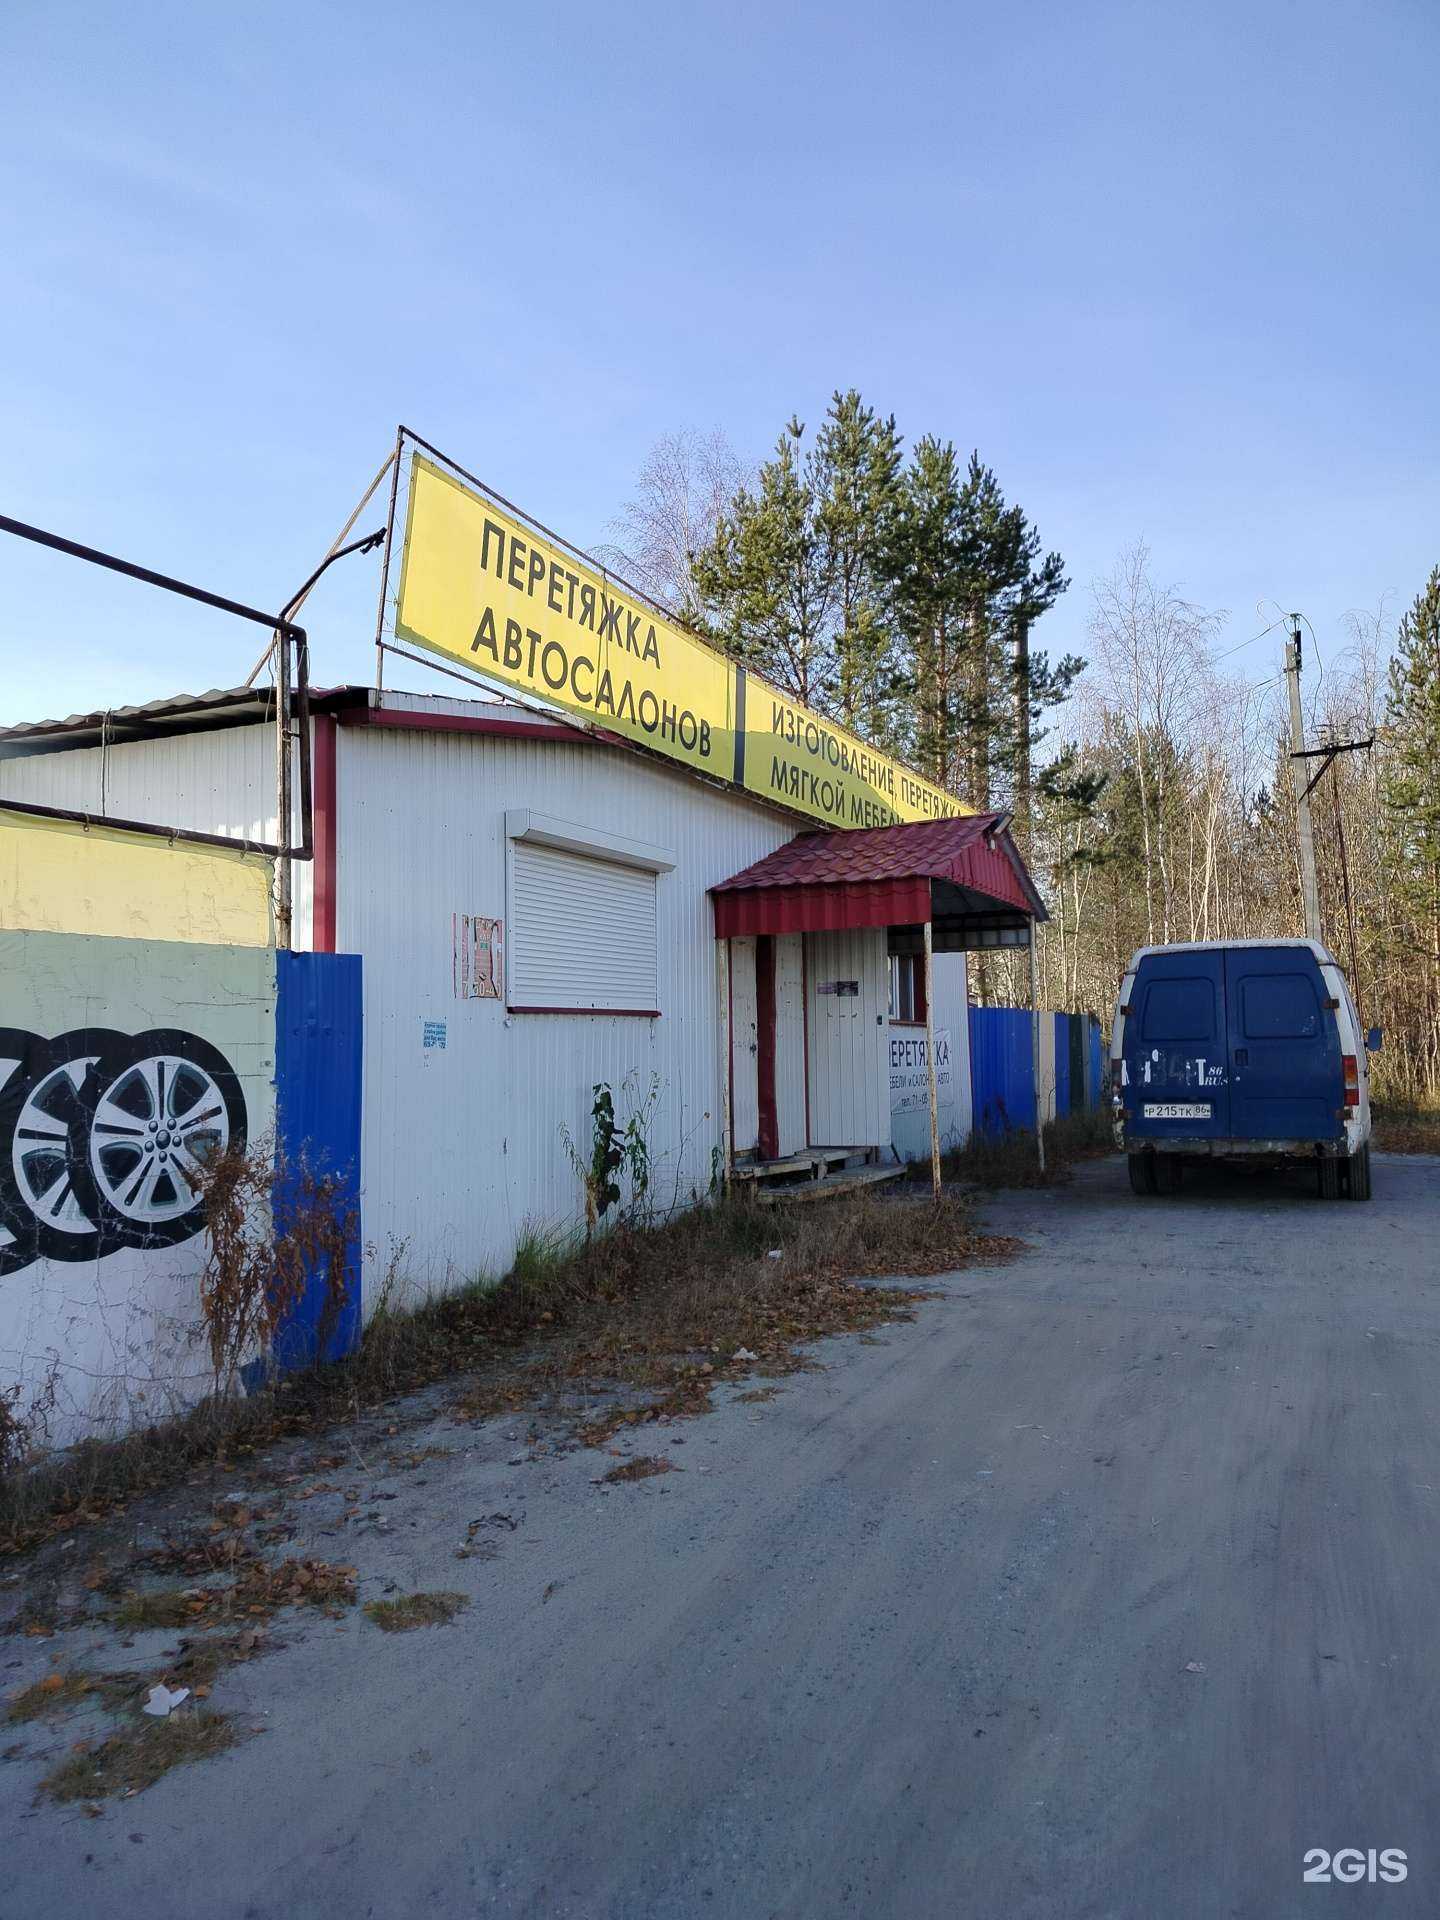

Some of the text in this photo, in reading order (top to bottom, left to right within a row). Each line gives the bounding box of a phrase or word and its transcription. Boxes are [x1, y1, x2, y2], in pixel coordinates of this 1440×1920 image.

[480, 518, 661, 670] ПЕРЕТЯЖКА
[471, 606, 712, 758] АВТОСАЛОНОВ
[770, 755, 845, 818] МЯГКОЙ
[889, 1039, 950, 1068] ЕРЕТЯКА
